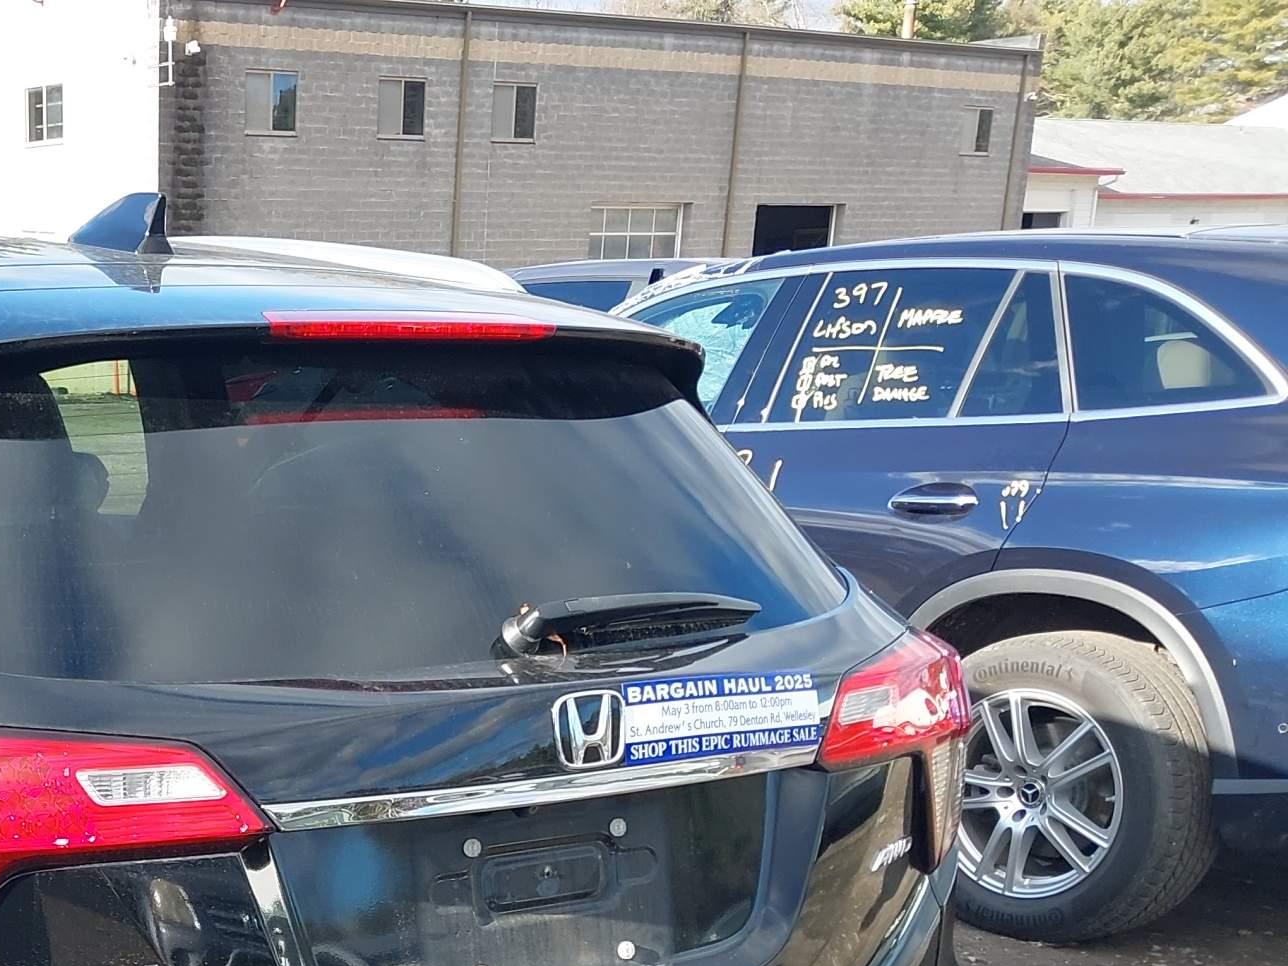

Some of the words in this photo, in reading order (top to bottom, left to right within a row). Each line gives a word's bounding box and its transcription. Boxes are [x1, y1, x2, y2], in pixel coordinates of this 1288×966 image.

[833, 281, 889, 309] 397
[627, 679, 718, 704] BARGAIN
[723, 676, 772, 694] HAUL
[774, 673, 813, 691] 2025
[661, 704, 682, 718] May
[684, 703, 690, 714] 3
[691, 701, 714, 714] from
[715, 698, 748, 712] 8:00am
[749, 698, 758, 709] to
[760, 696, 793, 710] 12:00pm
[630, 725, 643, 738] St.
[728, 715, 738, 728] 79
[740, 713, 769, 727] Denton
[783, 709, 816, 723] Wellesley
[630, 741, 667, 760] SHOP
[669, 737, 700, 755] THIS
[701, 734, 731, 751] EPIC
[733, 729, 792, 748] RUMMAGE
[793, 726, 818, 742] SALE
